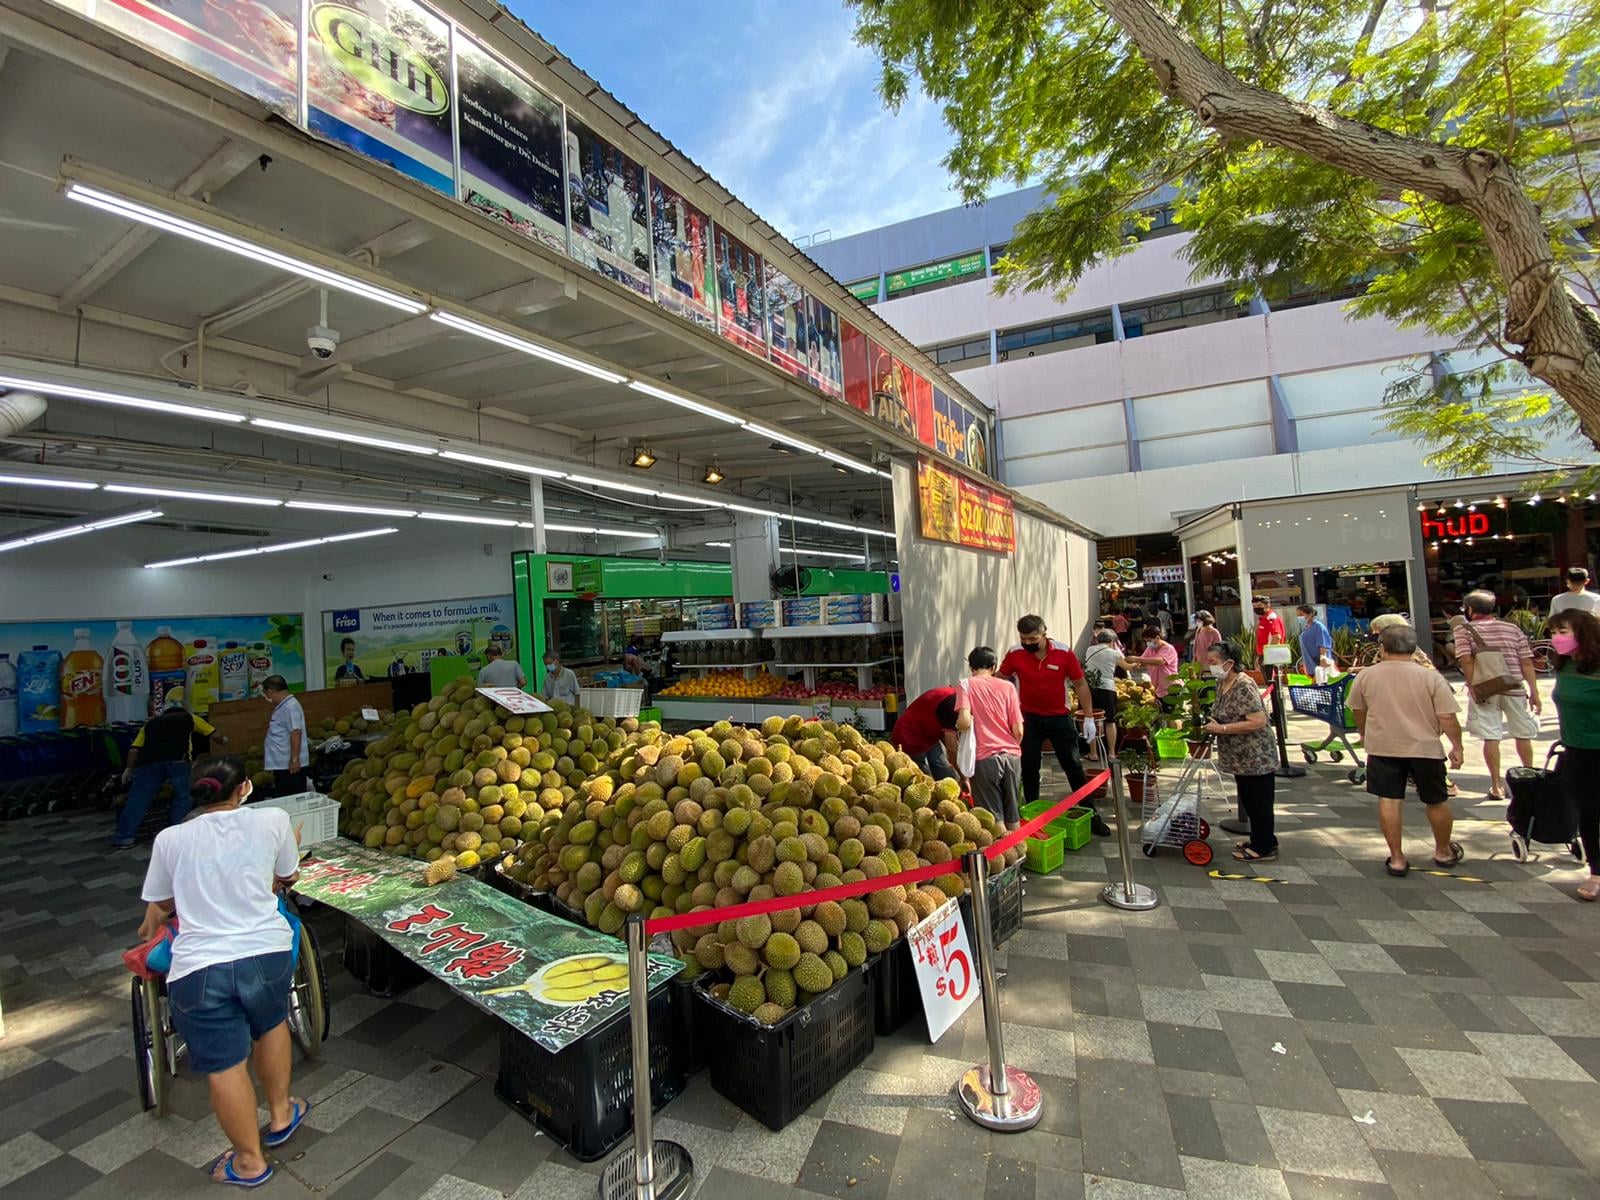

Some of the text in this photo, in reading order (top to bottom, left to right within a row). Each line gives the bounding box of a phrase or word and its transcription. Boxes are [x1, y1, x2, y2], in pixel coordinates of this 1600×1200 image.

[934, 410, 966, 460] Tiger
[335, 616, 358, 627] Friso
[373, 603, 502, 623] When it comes to formula milk,
[221, 653, 245, 666] Nutri
[133, 659, 142, 687] PLUS
